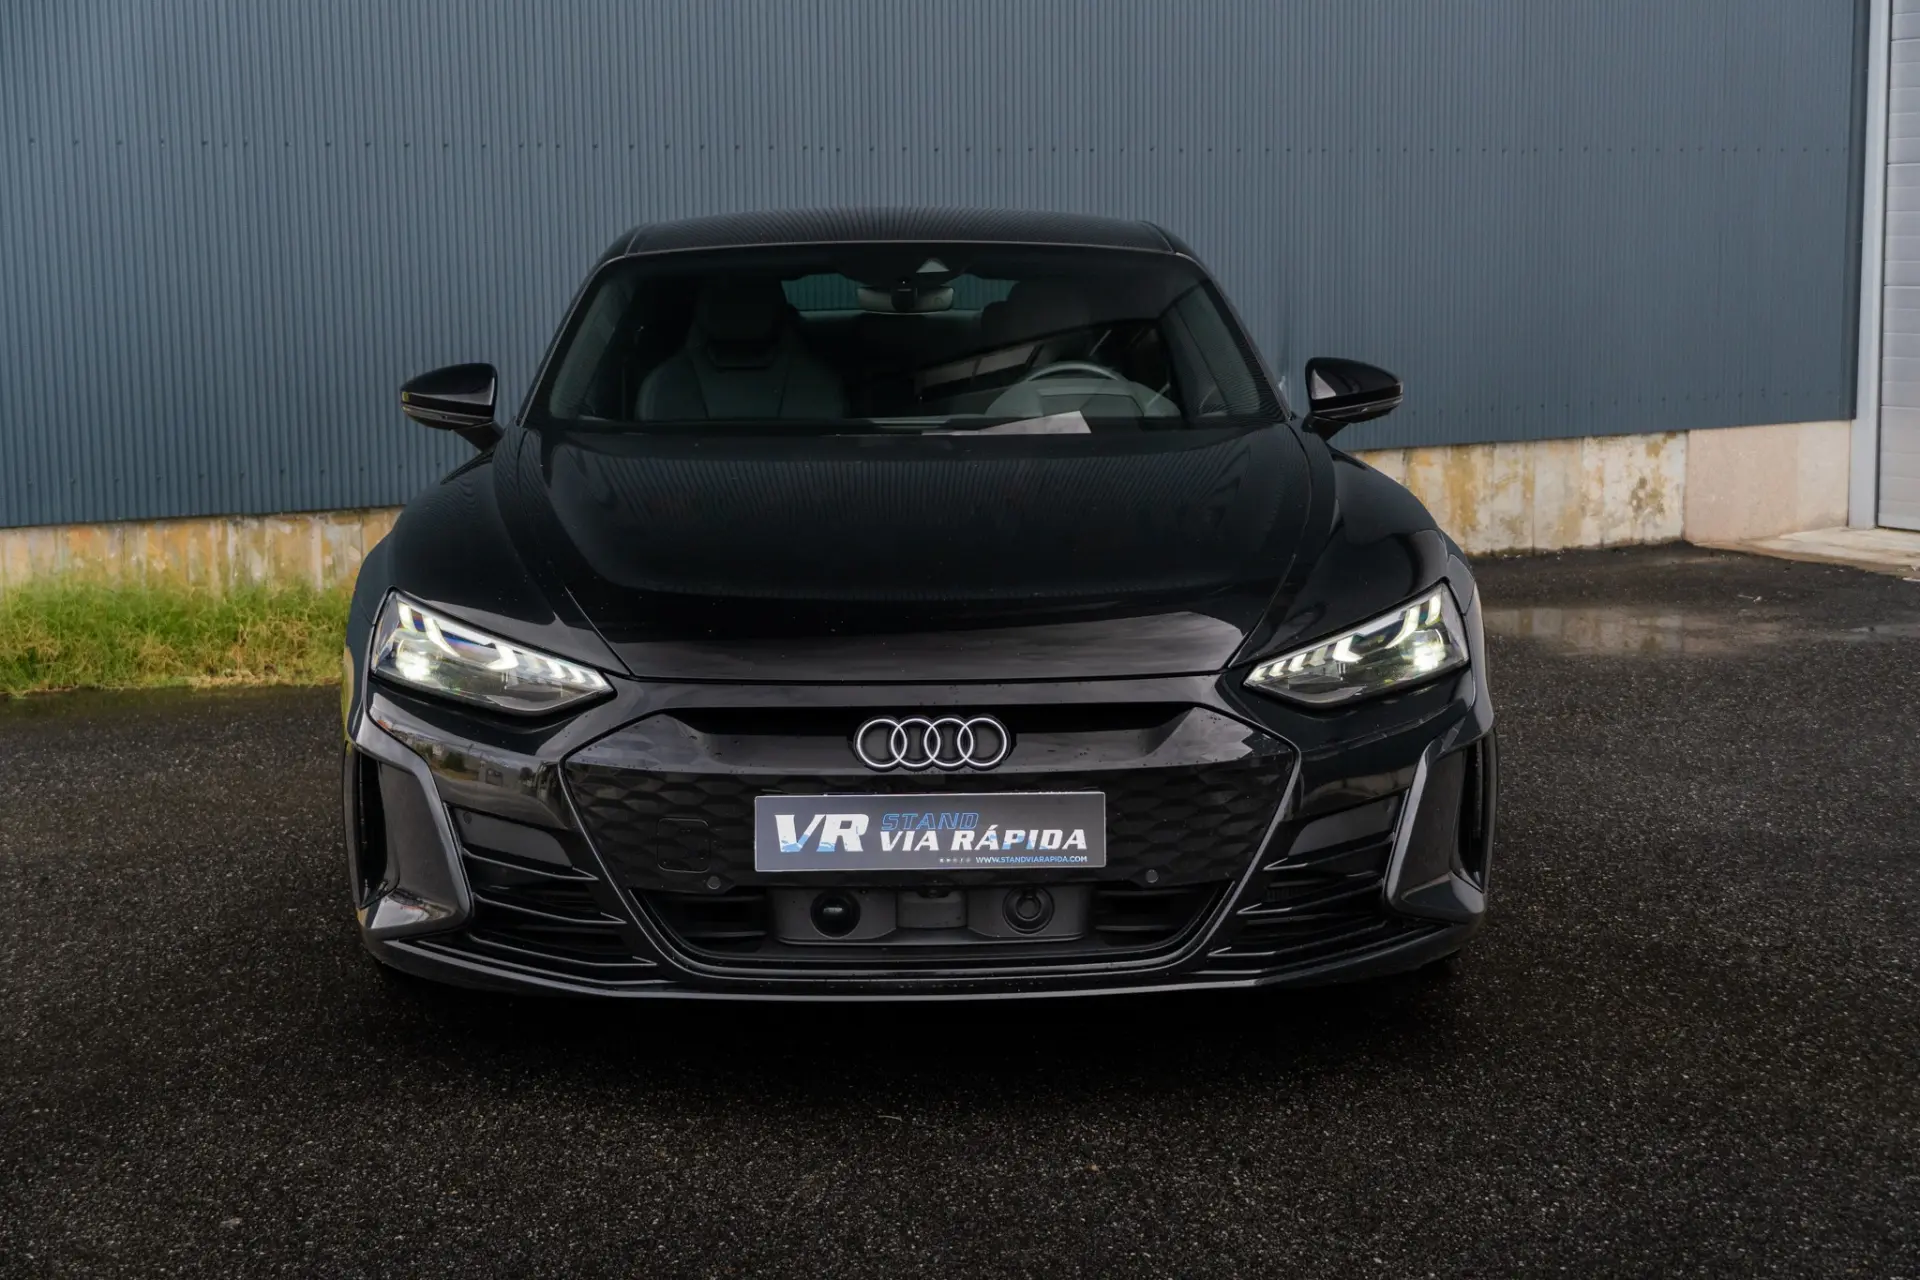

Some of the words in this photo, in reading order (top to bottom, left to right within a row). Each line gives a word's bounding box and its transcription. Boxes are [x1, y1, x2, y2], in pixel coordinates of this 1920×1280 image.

[881, 812, 979, 830] STAND
[775, 813, 869, 853] VR
[880, 830, 939, 852] VIA
[950, 824, 1088, 852] RÁPIDA
[976, 855, 1088, 864] WWW.STANDVIARAPIDA.COM
